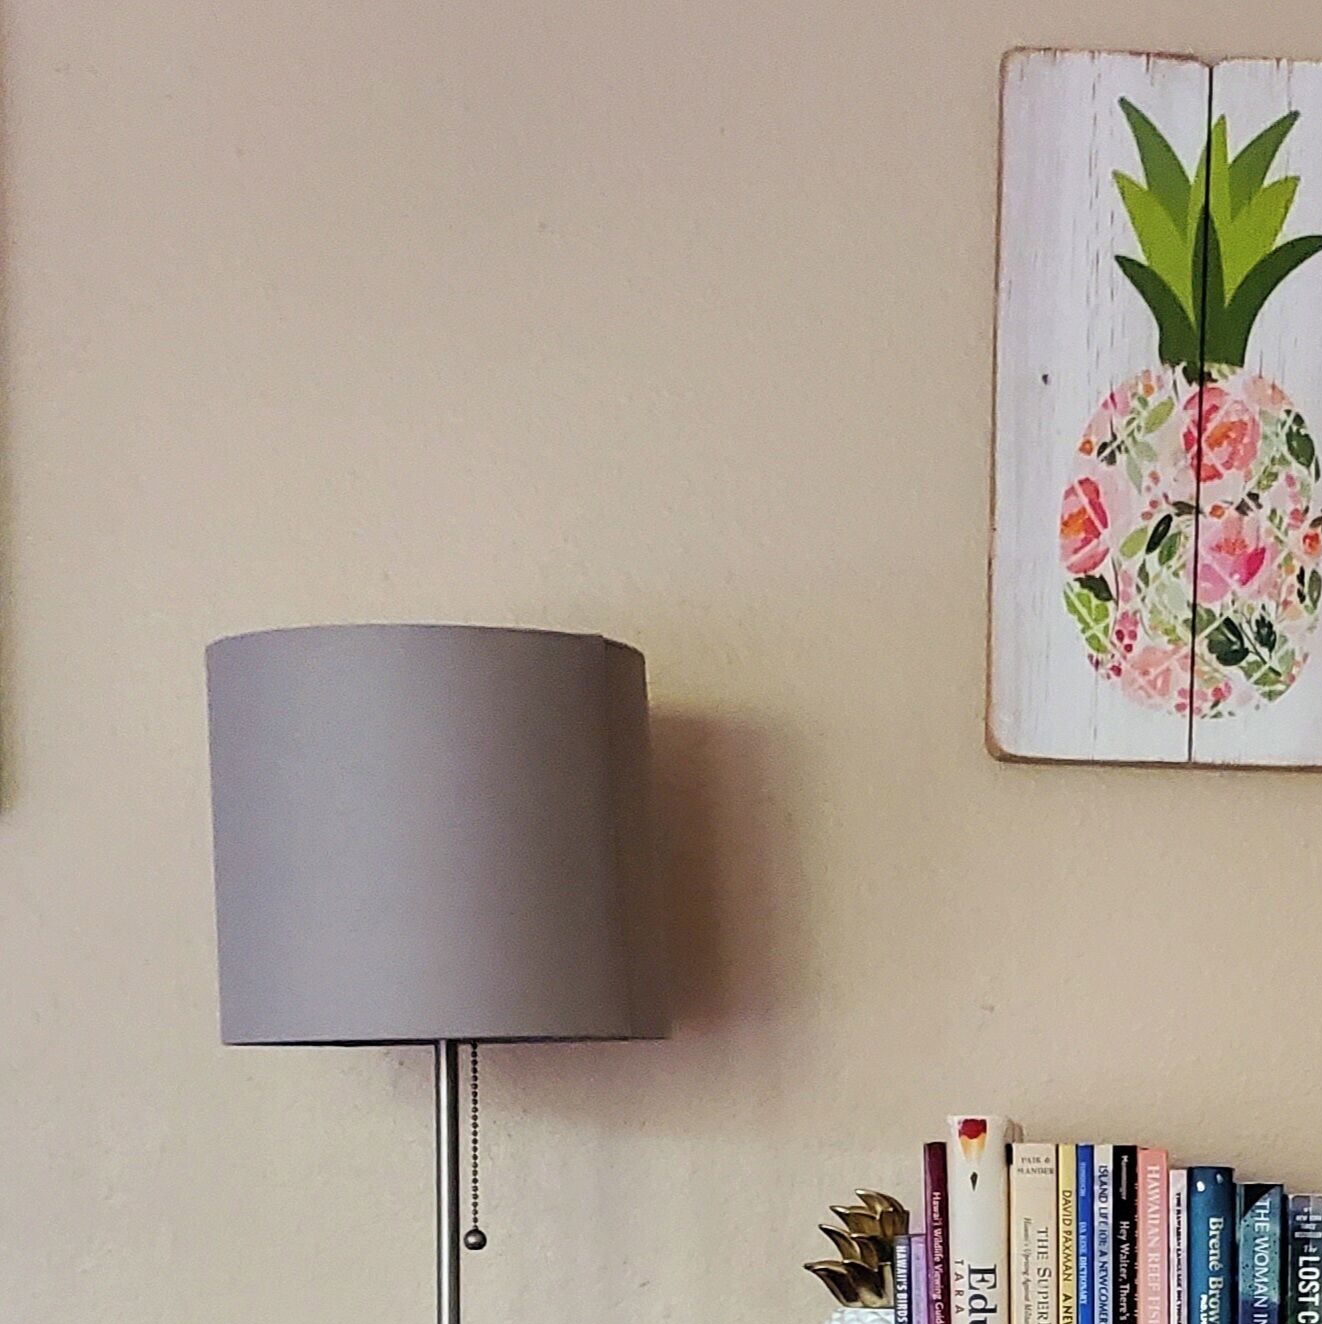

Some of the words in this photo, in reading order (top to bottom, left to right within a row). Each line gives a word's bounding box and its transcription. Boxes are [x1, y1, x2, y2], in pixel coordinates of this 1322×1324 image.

[1099, 1165, 1109, 1203] ISLAND
[1062, 1190, 1072, 1227] DAVID
[1099, 1206, 1109, 1226] LIFE
[1146, 1165, 1161, 1249] HAWAIIAN
[1254, 1199, 1270, 1232] THE
[934, 1228, 944, 1262] Wildlife
[1036, 1227, 1049, 1260] THE
[1117, 1221, 1130, 1241] Hey
[1208, 1217, 1224, 1271] Brené
[896, 1245, 908, 1291] HAWAII'S
[1062, 1230, 1073, 1282] PAXMAN
[1099, 1249, 1109, 1258] A
[1118, 1243, 1130, 1282] Waiter,
[1253, 1236, 1269, 1308] WOMAN
[931, 1264, 944, 1300] Viewing
[954, 1260, 965, 1314] TARA
[1079, 1256, 1088, 1305] DICTIONARY
[1147, 1253, 1161, 1292] REEF
[1298, 1255, 1320, 1306] LOST
[897, 1293, 908, 1323] BIRDS
[1063, 1293, 1073, 1303] A
[1119, 1284, 1131, 1321] There's
